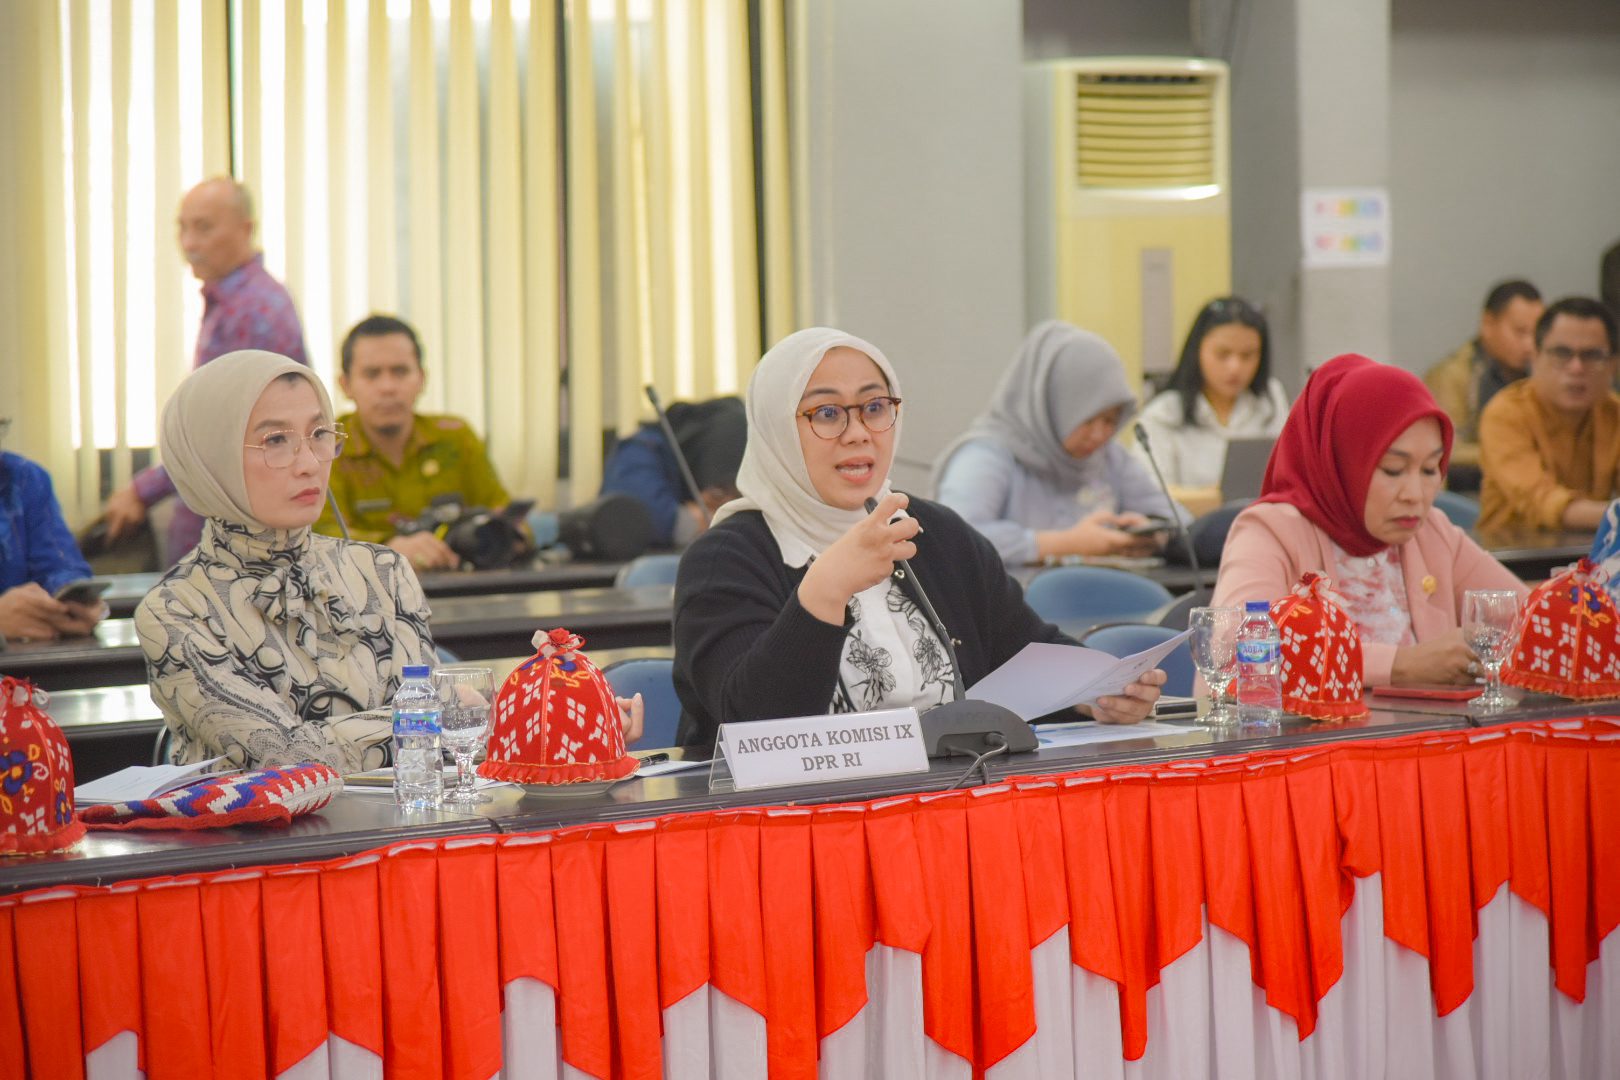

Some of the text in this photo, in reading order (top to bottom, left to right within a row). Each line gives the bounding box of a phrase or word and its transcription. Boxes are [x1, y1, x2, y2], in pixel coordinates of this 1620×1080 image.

[737, 723, 915, 754] ANGGOTA KOMISI IX
[801, 752, 863, 772] DPR RI
